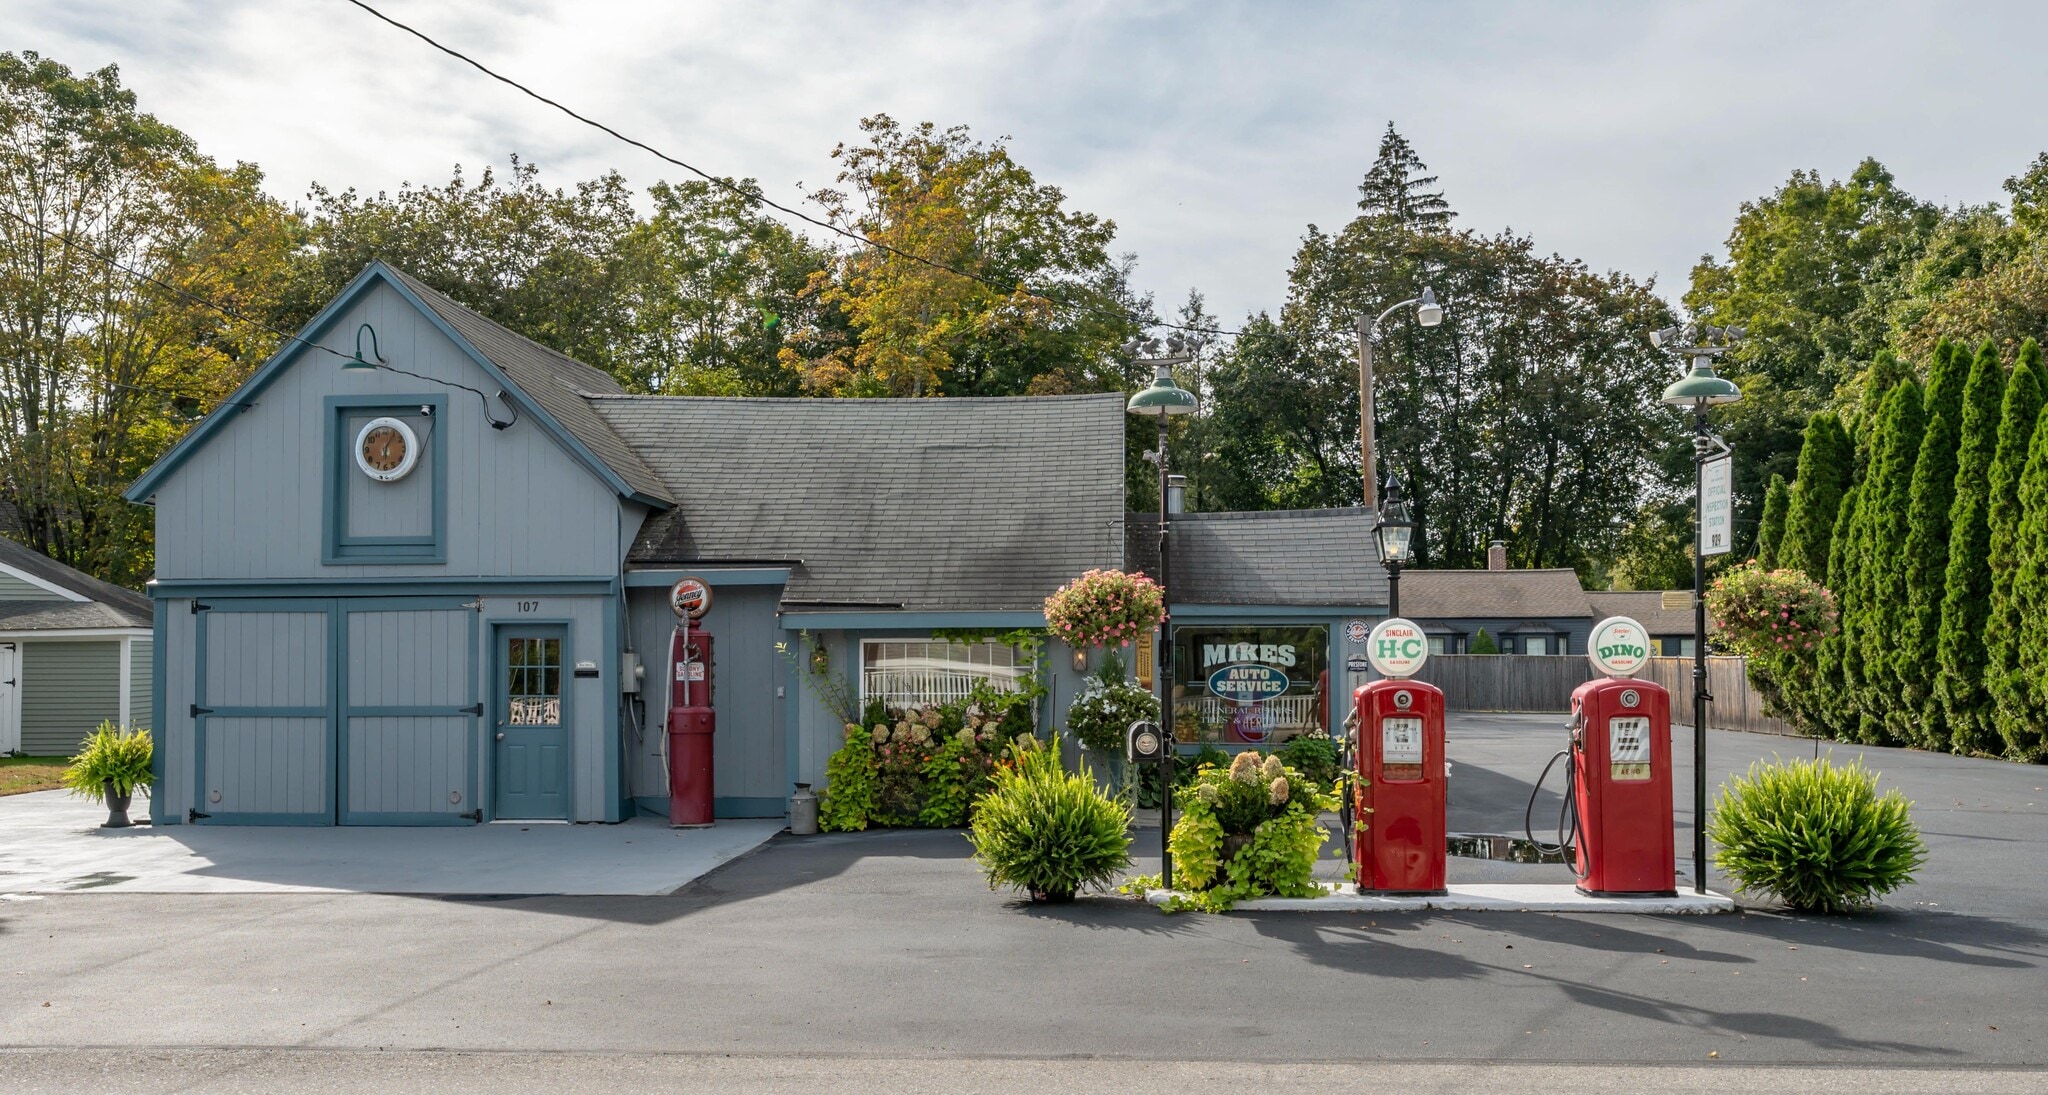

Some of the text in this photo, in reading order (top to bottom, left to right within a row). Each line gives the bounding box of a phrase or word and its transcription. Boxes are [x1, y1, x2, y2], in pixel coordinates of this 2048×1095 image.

[1708, 485, 1726, 497] OFFICIAL
[1706, 499, 1728, 513] INSPECTION
[1708, 516, 1724, 527] STATION
[517, 601, 538, 612] 107
[1203, 644, 1296, 668] MIKES
[1599, 644, 1644, 659] DINO
[1229, 668, 1270, 680] AUTO
[1216, 680, 1281, 692] SERVICE
